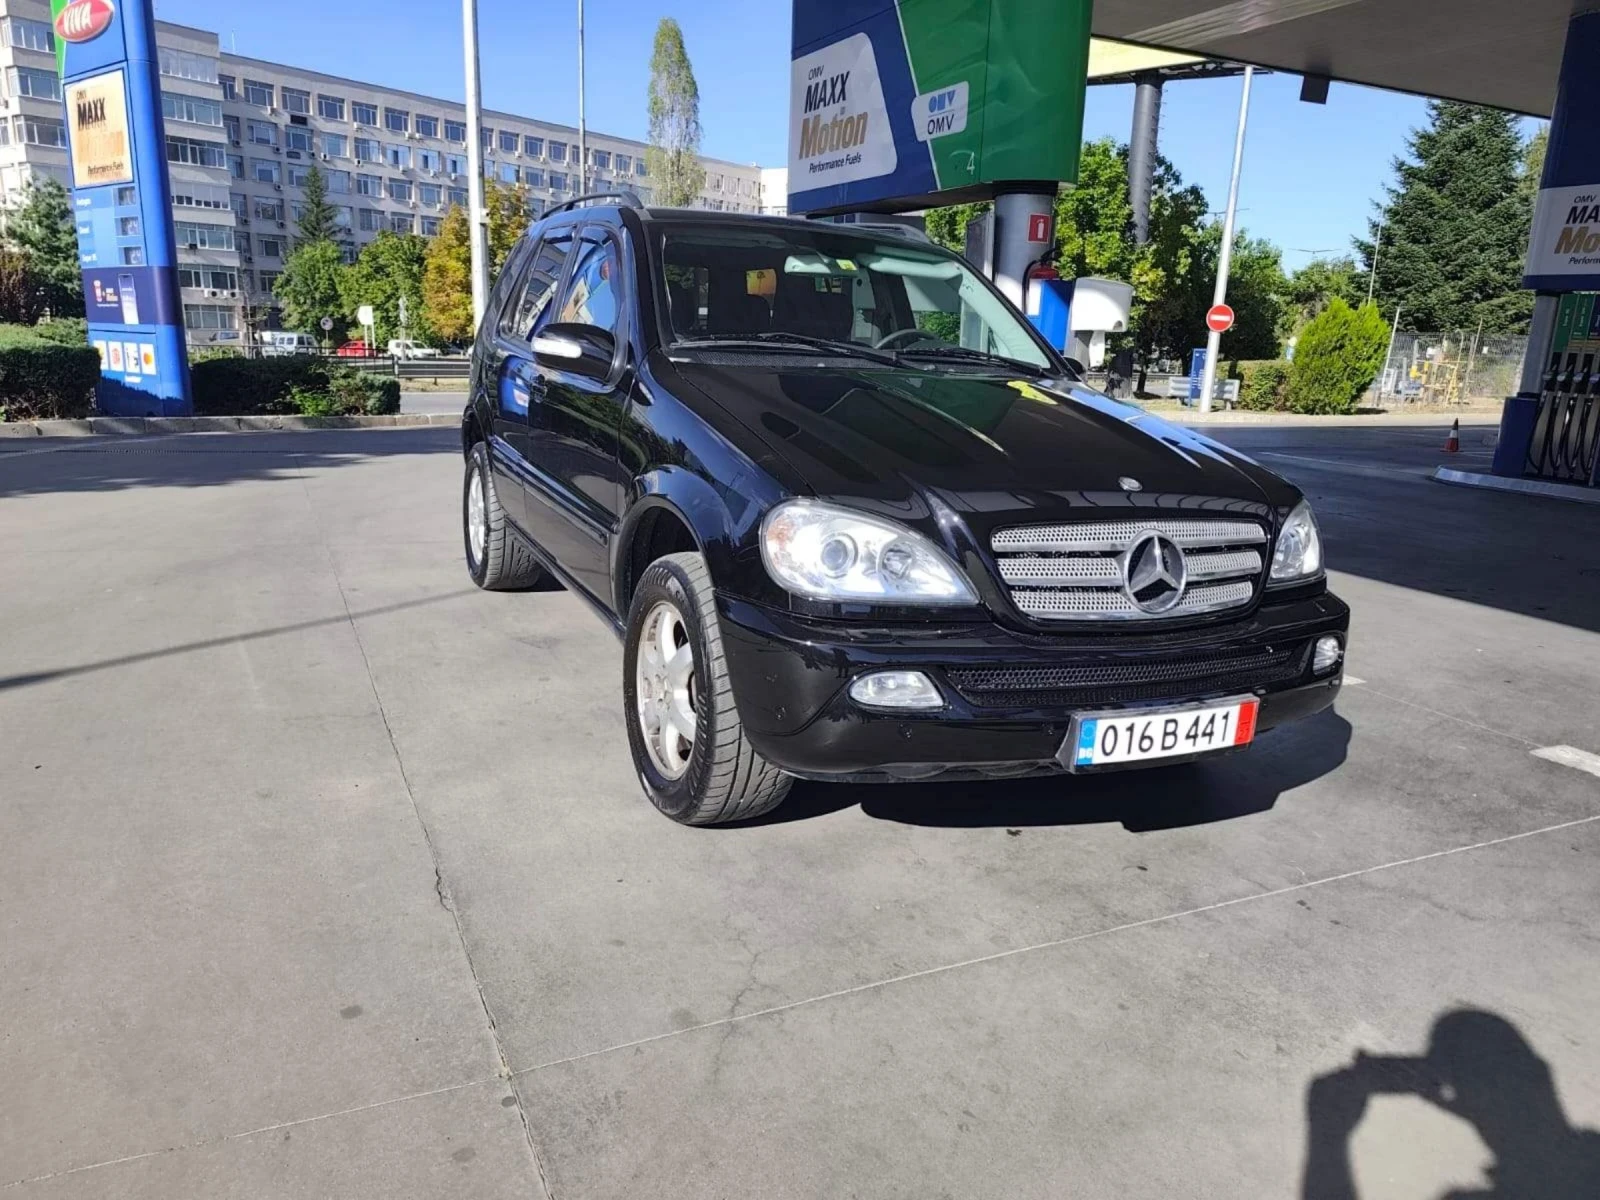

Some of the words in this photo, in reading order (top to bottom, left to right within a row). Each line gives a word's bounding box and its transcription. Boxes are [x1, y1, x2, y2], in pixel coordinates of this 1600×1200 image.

[64, 1, 92, 35] VIVA
[808, 65, 825, 80] OMV
[804, 71, 850, 113] MAXX
[77, 98, 106, 128] MAXX
[927, 113, 955, 135] OMV
[799, 107, 868, 160] Motion
[809, 156, 845, 174] Performance
[844, 152, 862, 166] Fuels
[966, 151, 976, 175] 4
[1573, 194, 1597, 204] OMV
[1566, 205, 1600, 224] MA
[1554, 226, 1600, 254] Mo
[1101, 721, 1154, 757] 016
[1161, 718, 1179, 751] B
[1185, 710, 1232, 747] 441
